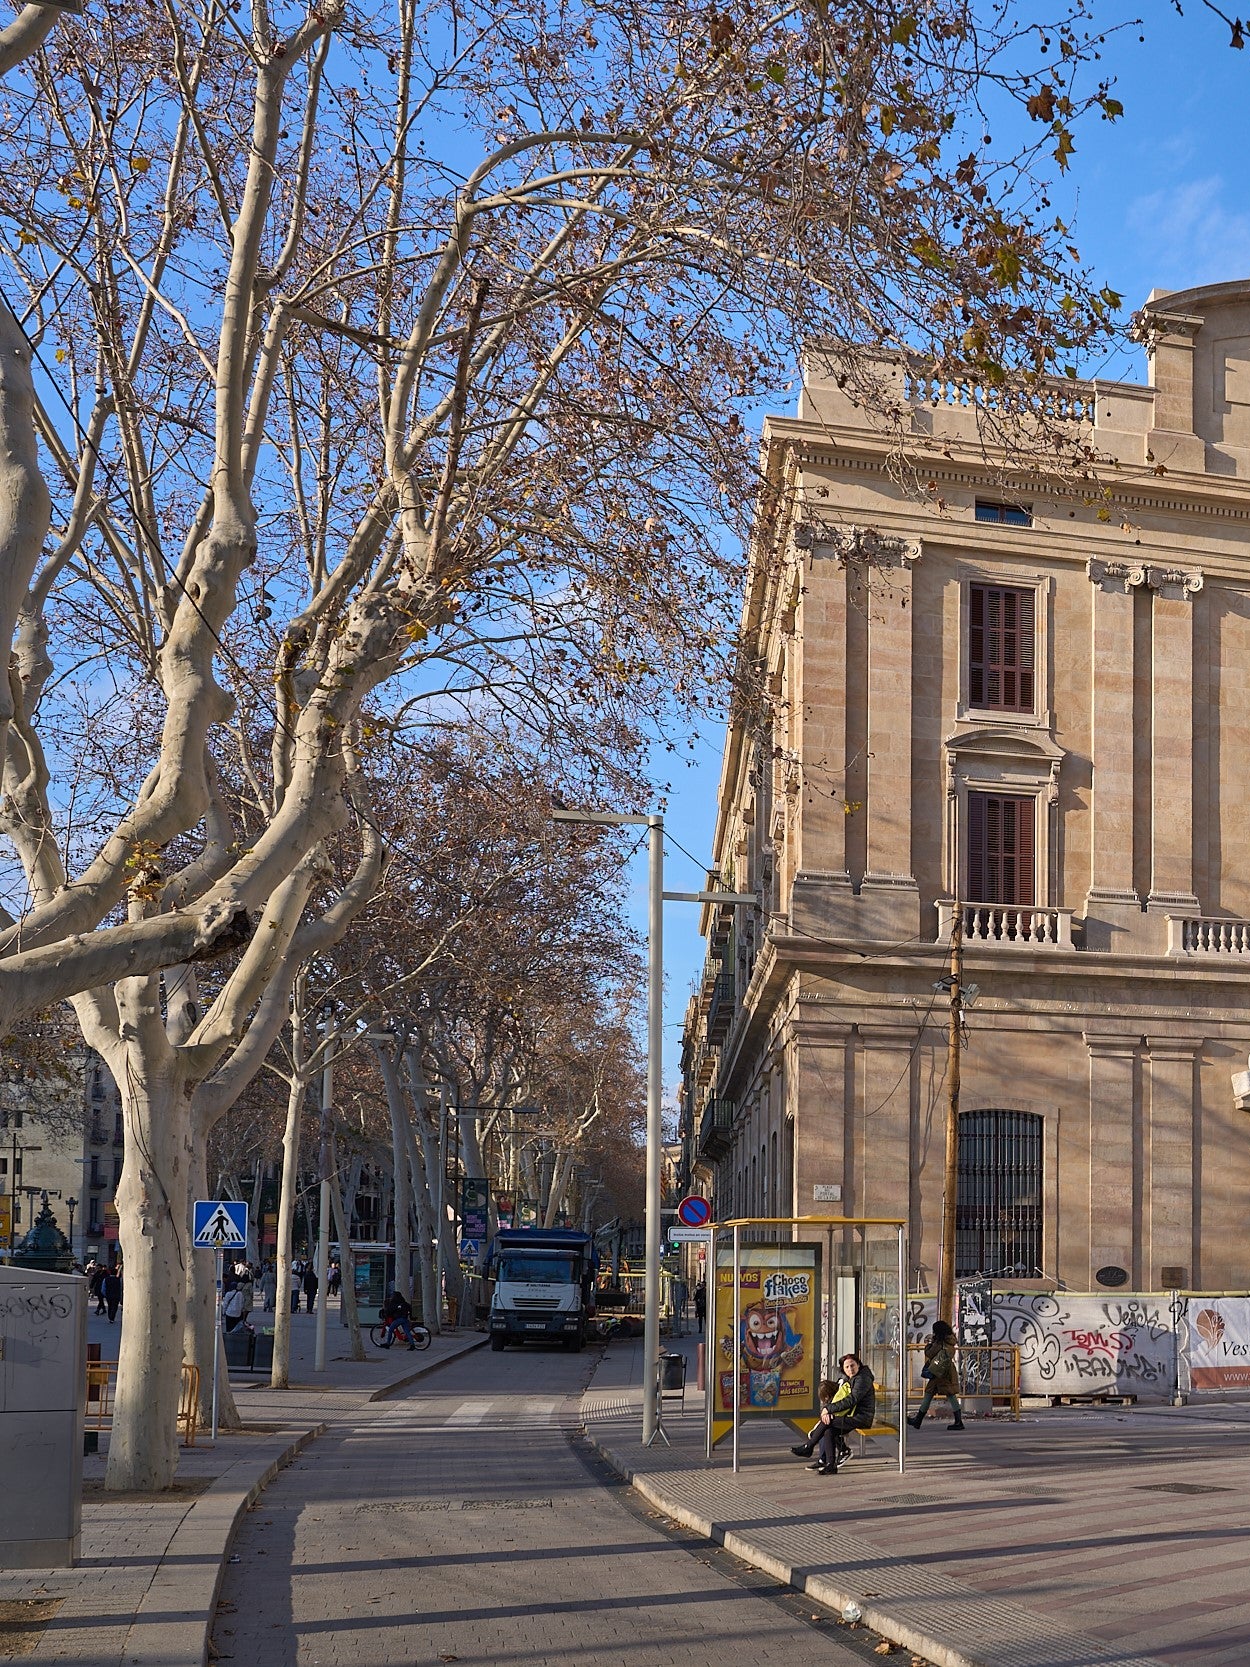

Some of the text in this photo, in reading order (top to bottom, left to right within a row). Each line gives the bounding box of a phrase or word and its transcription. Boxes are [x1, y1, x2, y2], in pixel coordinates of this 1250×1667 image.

[720, 1273, 758, 1283] NUVOS
[772, 1274, 806, 1286] Choco
[764, 1279, 808, 1298] flakes
